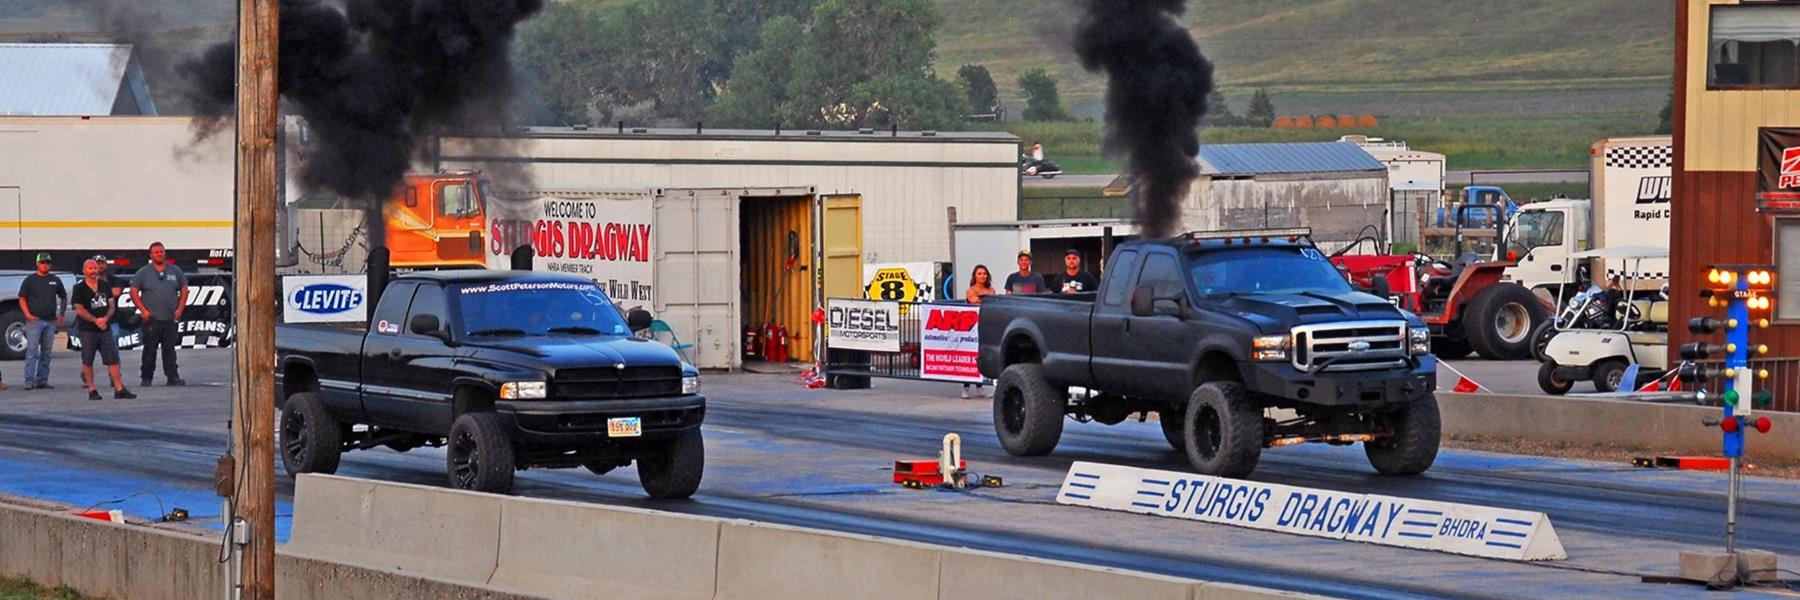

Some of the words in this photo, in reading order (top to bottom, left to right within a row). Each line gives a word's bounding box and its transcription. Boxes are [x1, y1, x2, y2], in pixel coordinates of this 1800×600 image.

[544, 201, 583, 219] WELCOME
[585, 203, 596, 219] TO
[1634, 210, 1661, 221] Rapid
[568, 222, 652, 262] DRAGWAY
[876, 272, 908, 281] STAGE
[288, 284, 361, 310] CLEVITE
[461, 282, 596, 294] www.ScottPetersonMotors.com
[631, 281, 651, 301] WEST
[880, 281, 905, 300] 8
[187, 321, 226, 333] FANS
[830, 307, 898, 331] DIESEL
[925, 309, 979, 332] ARP
[840, 330, 887, 340] MOTORSPORTS
[1165, 479, 1271, 522] STURGIS
[1277, 492, 1404, 538] DRAGWAY
[1439, 518, 1488, 540] BHDRA
